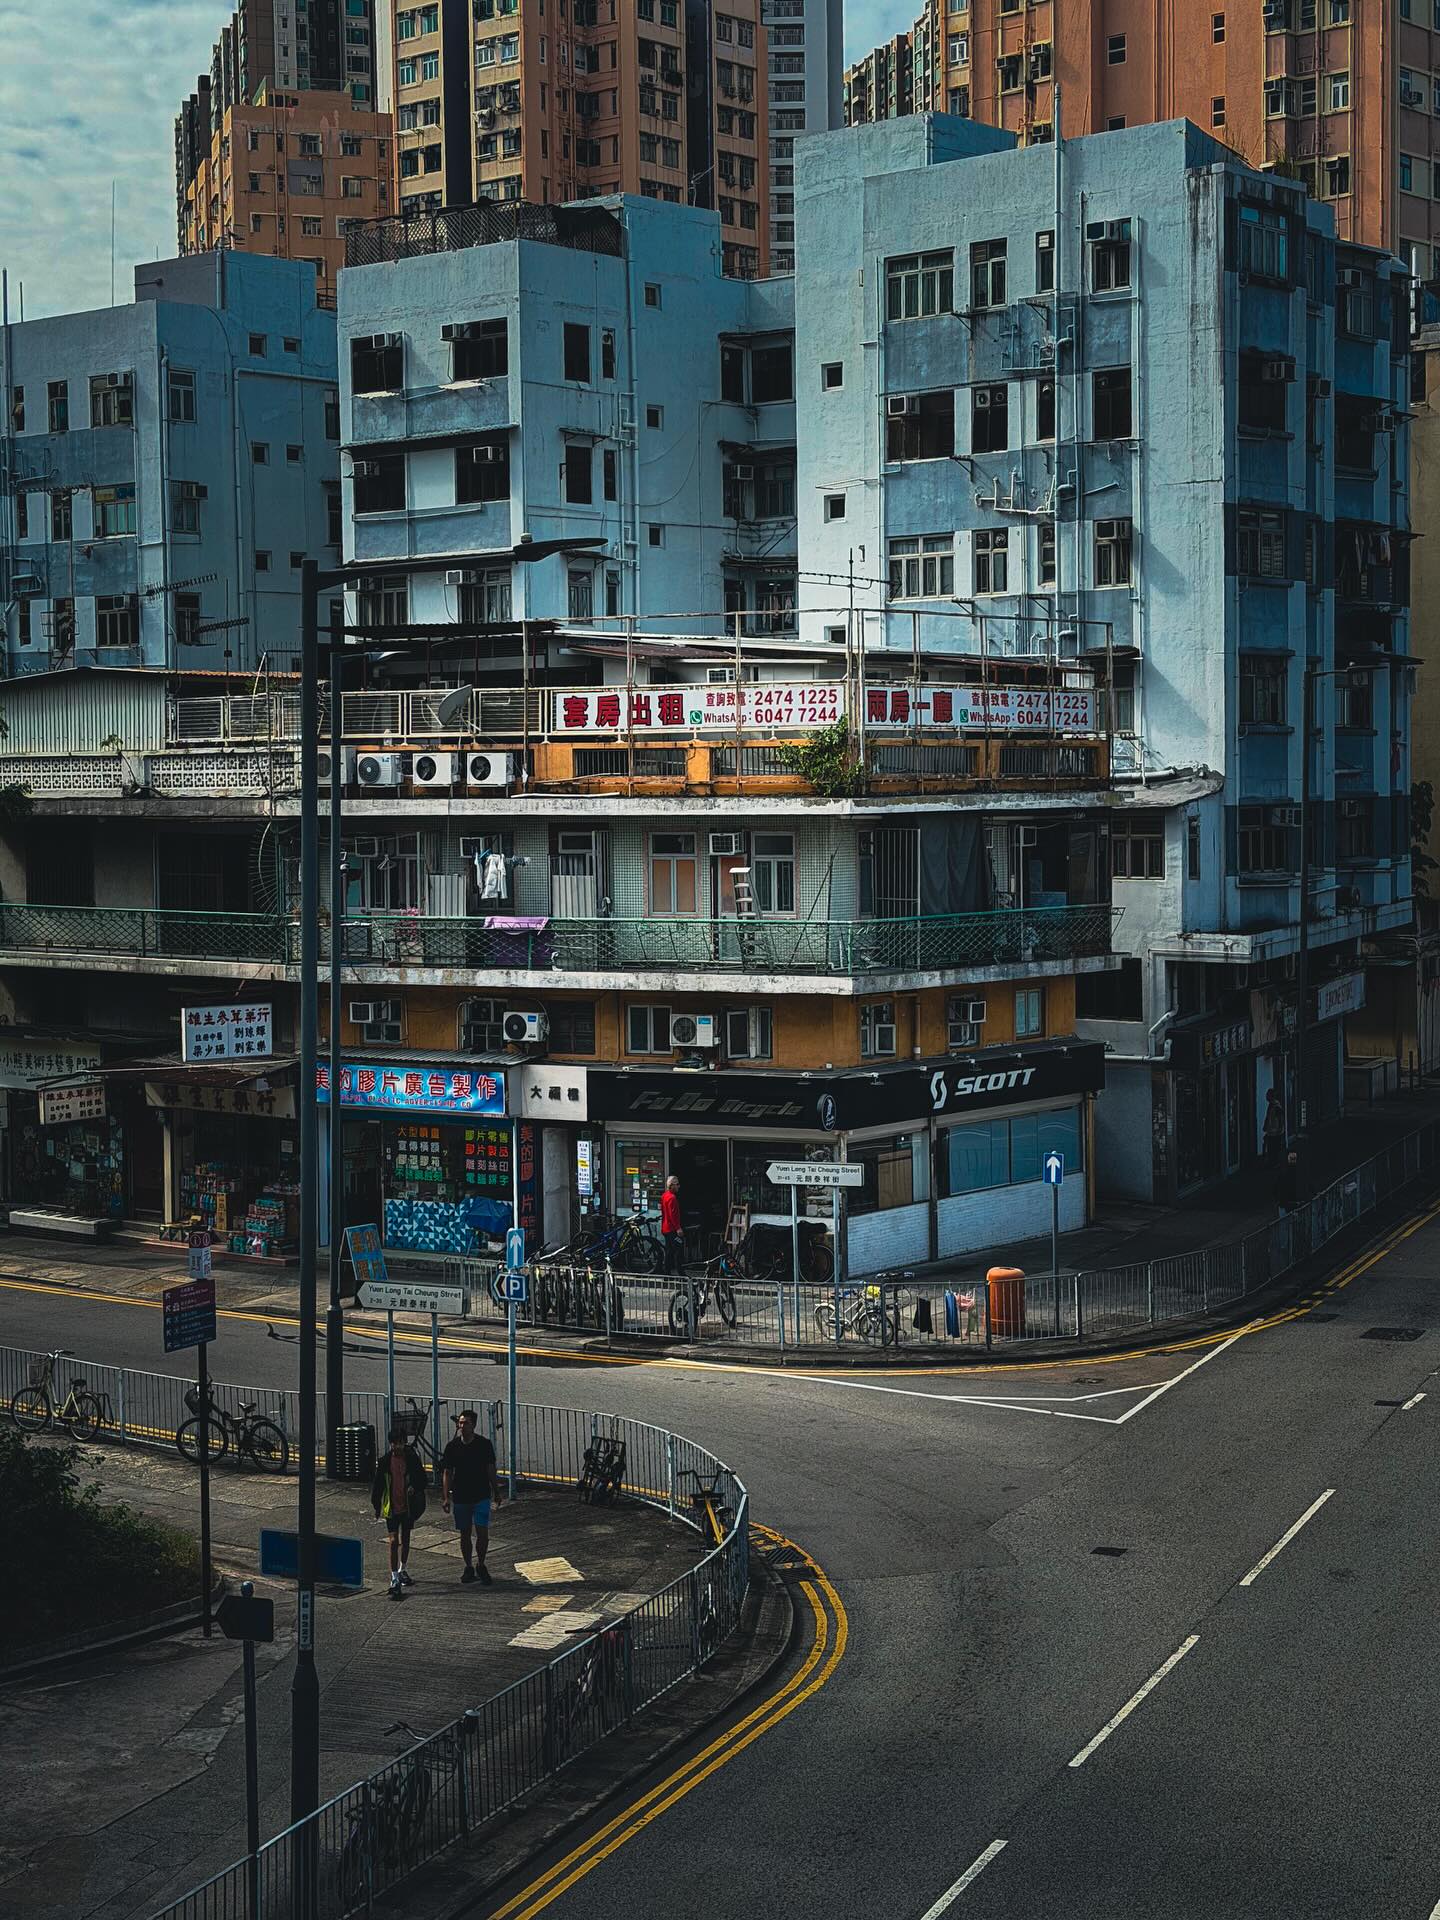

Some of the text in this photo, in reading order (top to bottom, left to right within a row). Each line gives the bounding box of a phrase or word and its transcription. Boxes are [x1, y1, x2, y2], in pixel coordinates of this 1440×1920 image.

[754, 690, 793, 706] 2474
[798, 689, 838, 704] 1225
[1017, 693, 1050, 708] 2474
[1055, 695, 1088, 709] 1225
[563, 693, 685, 728] 套房出租
[867, 690, 953, 723] 兩房一廳
[703, 707, 838, 724] WhatsAp: 6047 7244
[1017, 710, 1050, 724] 6047
[1055, 711, 1088, 725] 7244
[955, 1067, 1036, 1096] SCOTT
[717, 1098, 805, 1118] Bicycle
[817, 1166, 840, 1174] Cheung
[368, 1285, 461, 1299] Yuen Long Tai Cheung Street
[510, 1279, 521, 1296] P
